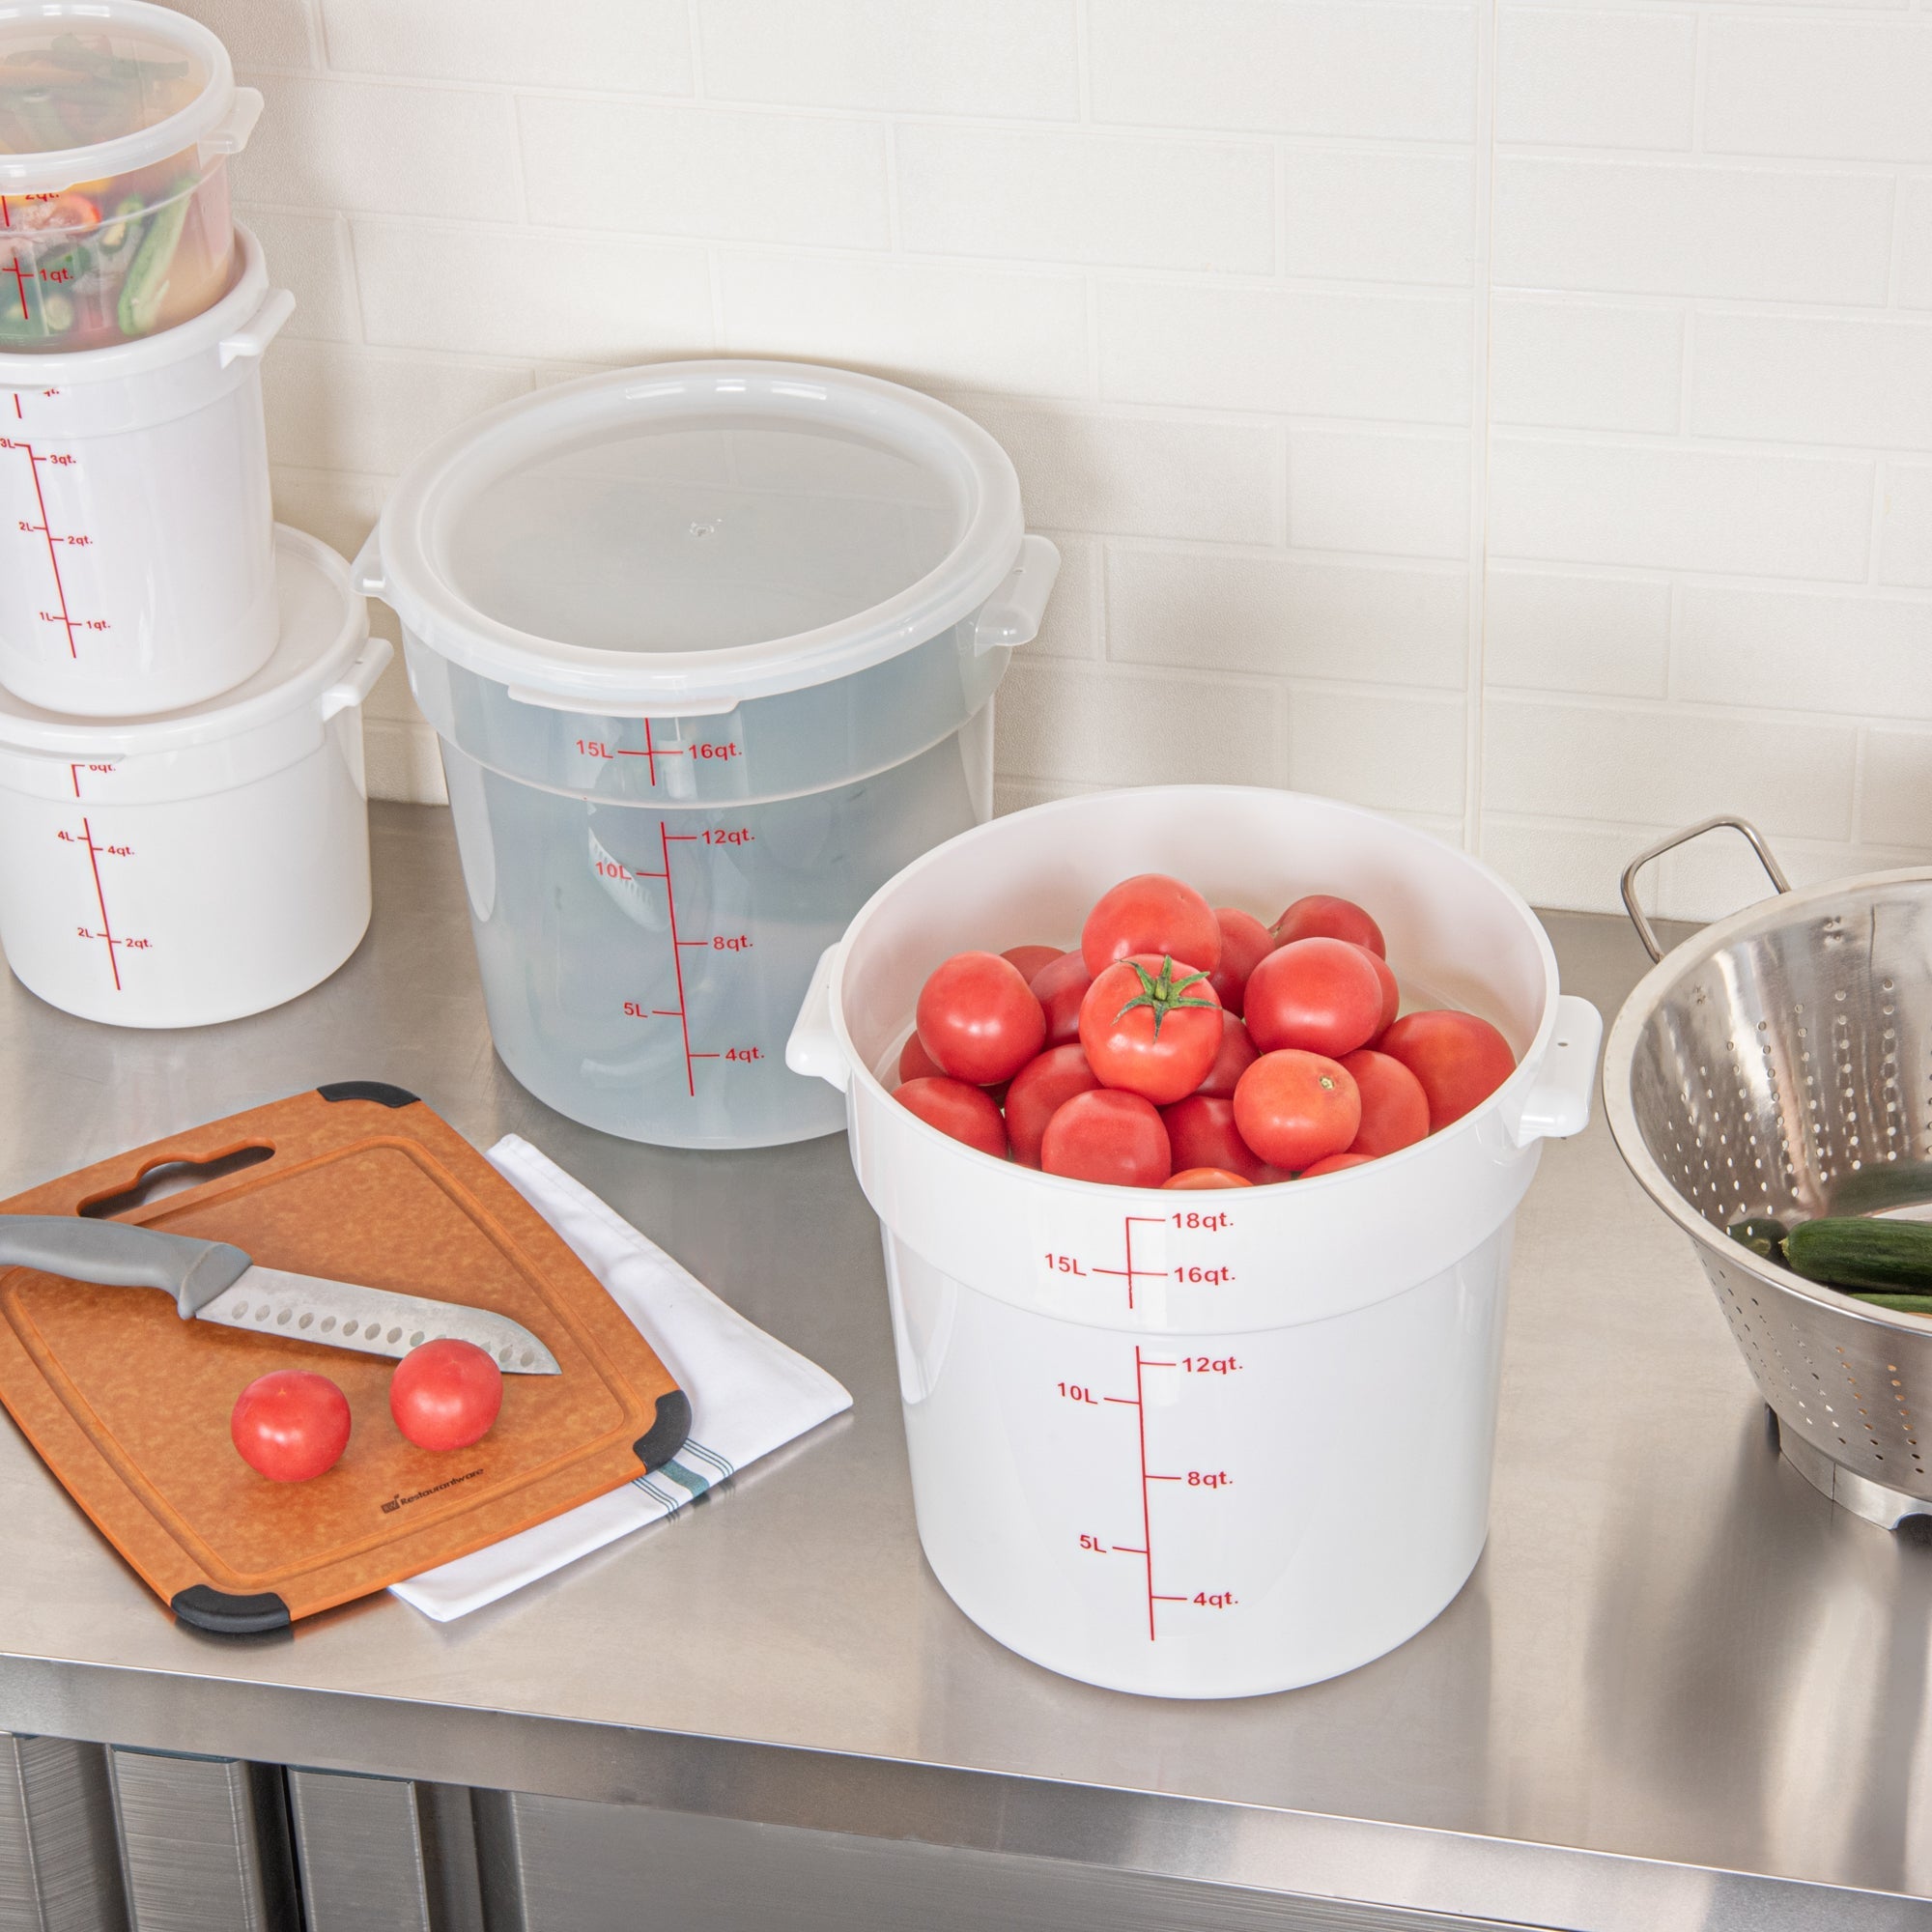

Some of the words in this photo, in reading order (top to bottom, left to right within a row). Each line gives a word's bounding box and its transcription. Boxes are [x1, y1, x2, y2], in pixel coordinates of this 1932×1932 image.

[40, 269, 73, 283] 1qt.
[0, 438, 15, 449] 3L
[49, 454, 76, 466] 3qt.
[18, 522, 34, 532] 2L
[68, 535, 94, 547] 2qt.
[39, 611, 53, 622] 1L
[86, 620, 111, 631] 1qt.
[576, 740, 614, 759] 15L
[689, 742, 743, 760] 16qt.
[57, 831, 74, 842] 4L
[701, 828, 755, 845] 12qt.
[107, 845, 135, 857] 4qt.
[595, 862, 633, 881] 10L
[77, 927, 94, 939] 2L
[126, 938, 153, 950] 2qt.
[713, 934, 753, 952] 8qt.
[623, 1002, 648, 1018] 5L
[725, 1045, 765, 1063] 4qt.
[1172, 1211, 1234, 1232] 18qt.
[1044, 1253, 1087, 1276] 15L
[1174, 1265, 1236, 1285] 16qt.
[1181, 1356, 1243, 1374] 12qt.
[1057, 1381, 1098, 1405] 10L
[401, 1468, 484, 1505] Restaurantware
[1187, 1469, 1234, 1488] 8qt.
[1079, 1534, 1107, 1553] 5L
[1193, 1589, 1239, 1607] 4qt.
